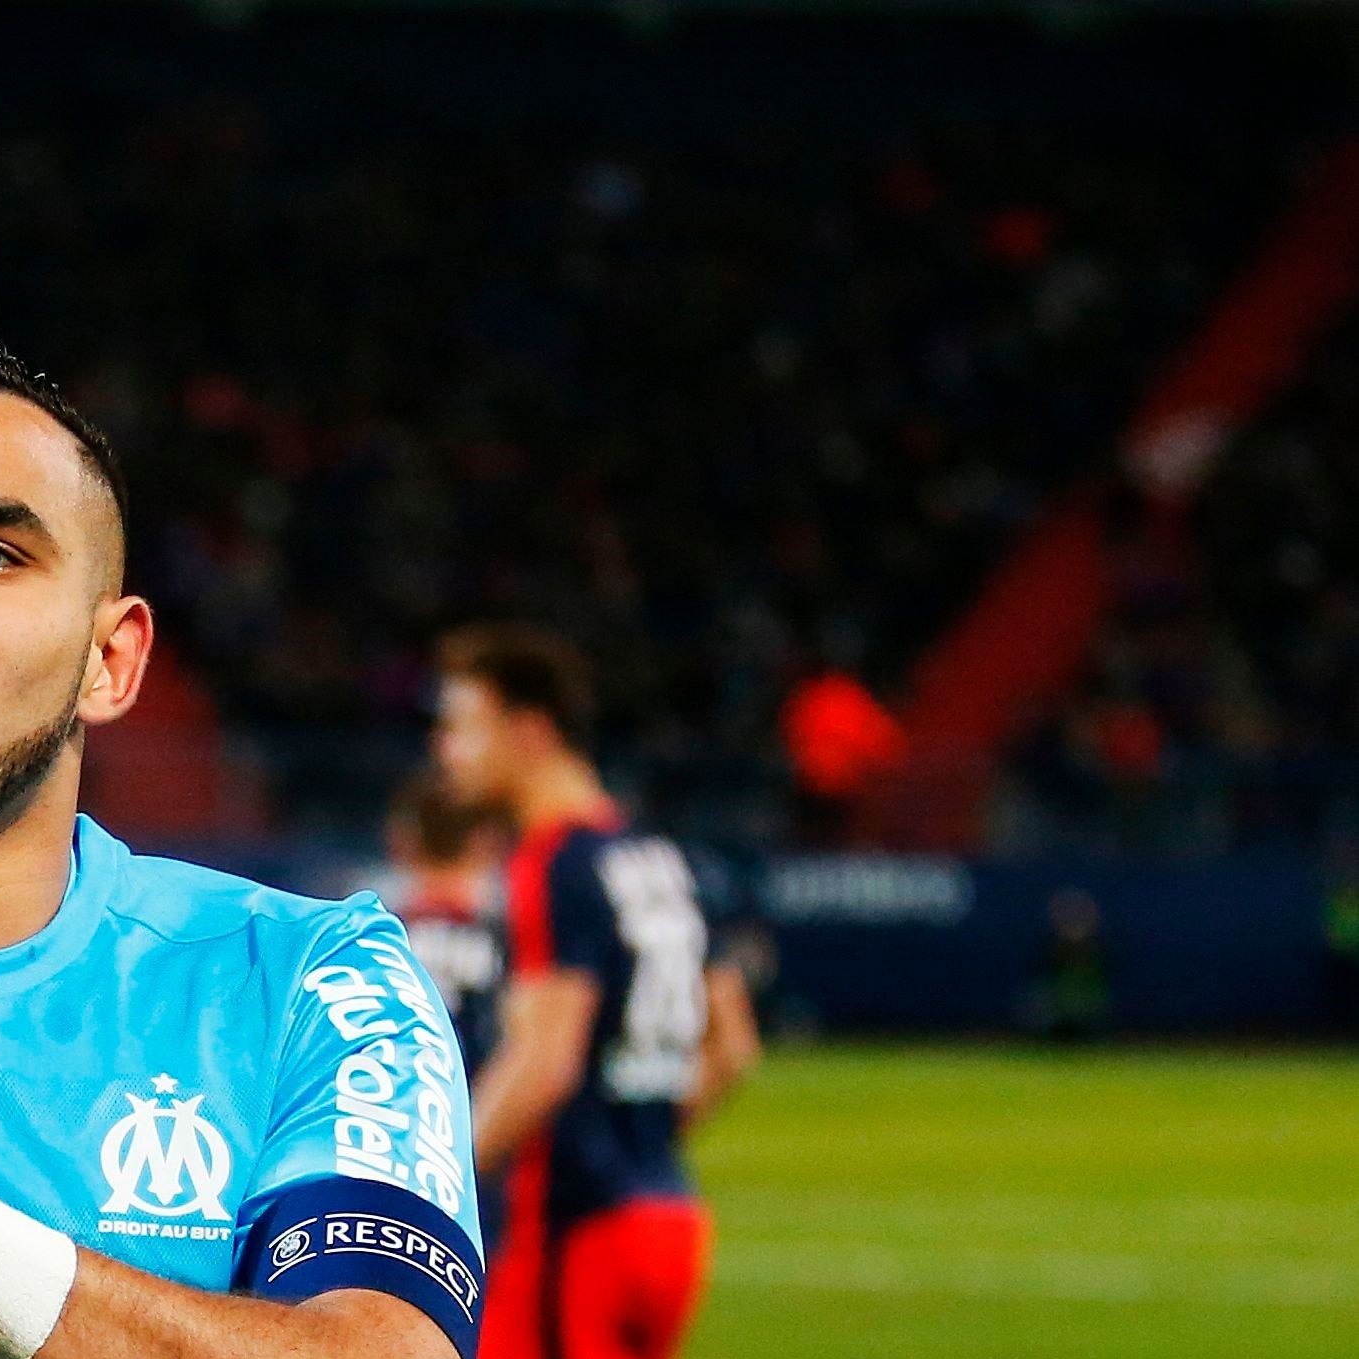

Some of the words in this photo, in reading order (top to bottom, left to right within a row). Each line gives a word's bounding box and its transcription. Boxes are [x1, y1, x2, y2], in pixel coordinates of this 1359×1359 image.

[303, 965, 399, 1041] du
[98, 1220, 159, 1237] DROIT
[159, 1225, 188, 1239] AU
[190, 1227, 232, 1241] BUT
[326, 1221, 478, 1307] RESPECT
